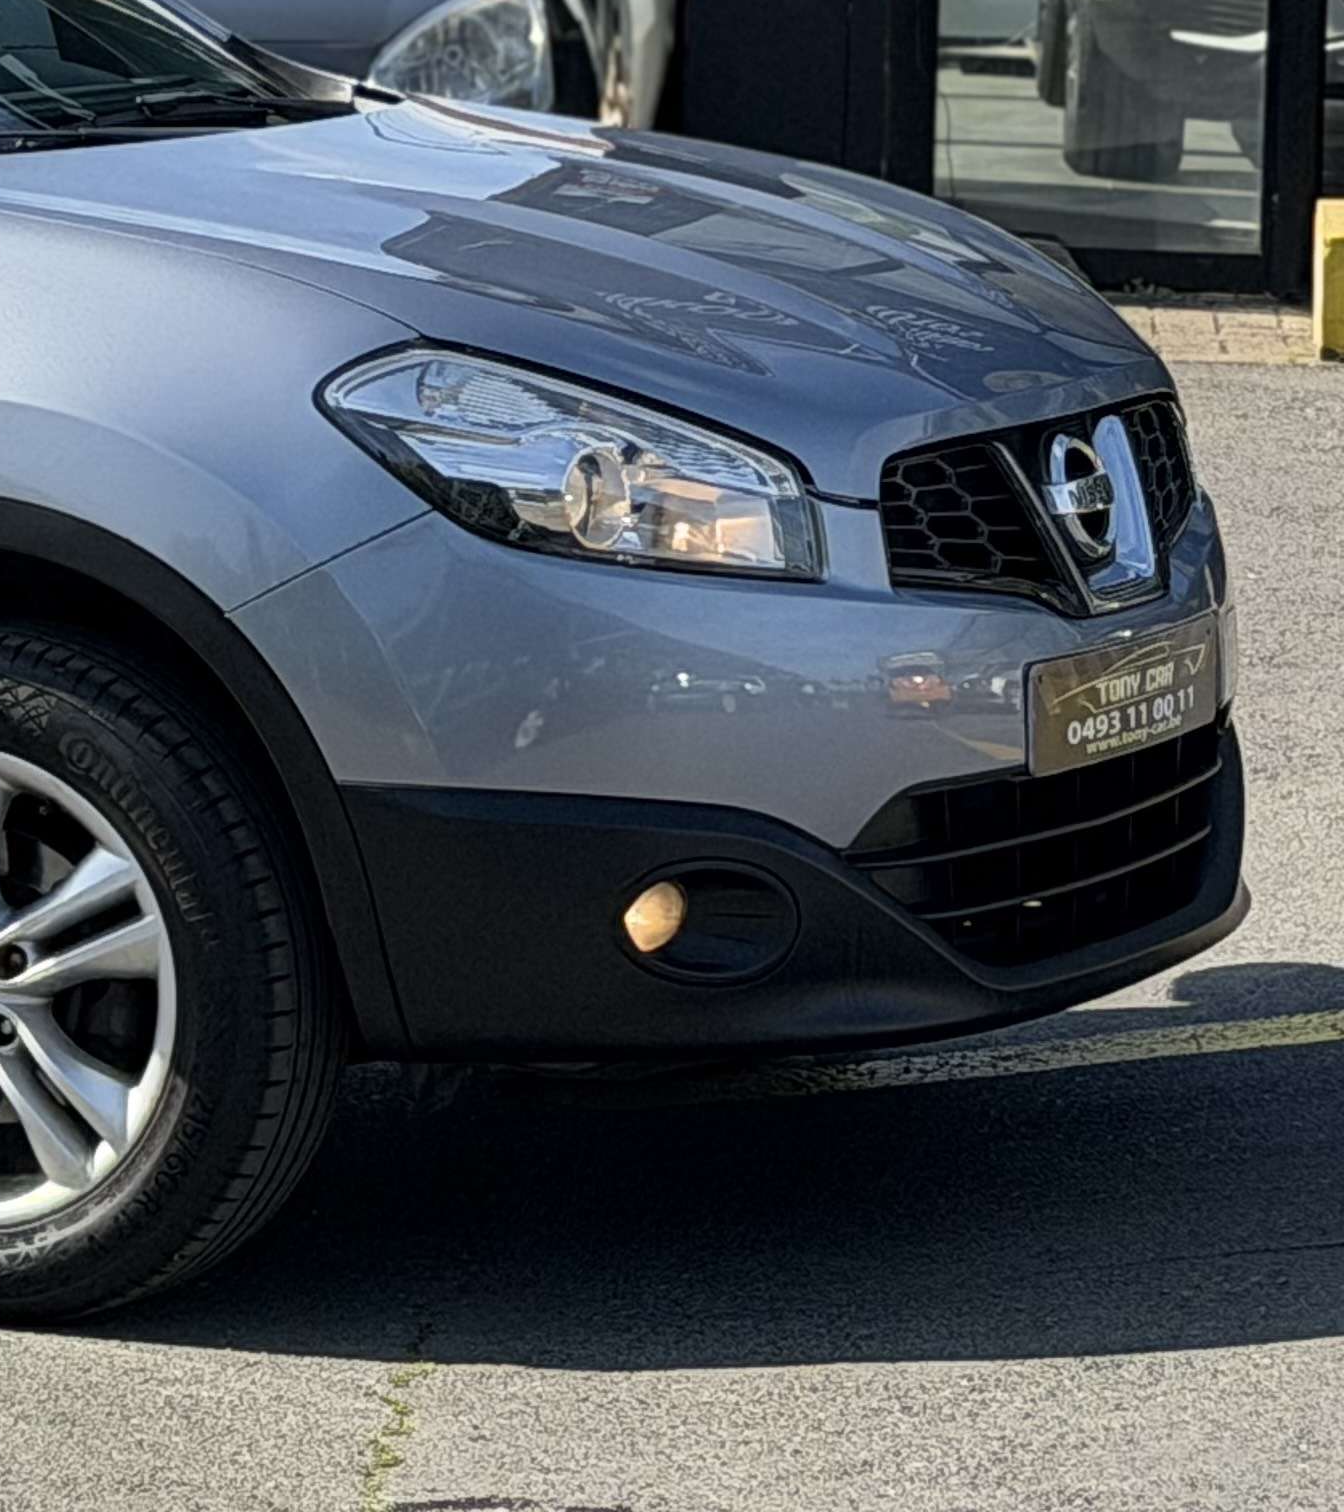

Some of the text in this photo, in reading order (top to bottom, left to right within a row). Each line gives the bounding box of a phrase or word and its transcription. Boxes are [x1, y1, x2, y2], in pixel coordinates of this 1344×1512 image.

[1095, 661, 1176, 705] TONY CAR
[1067, 685, 1195, 745] 0493 11 00 11
